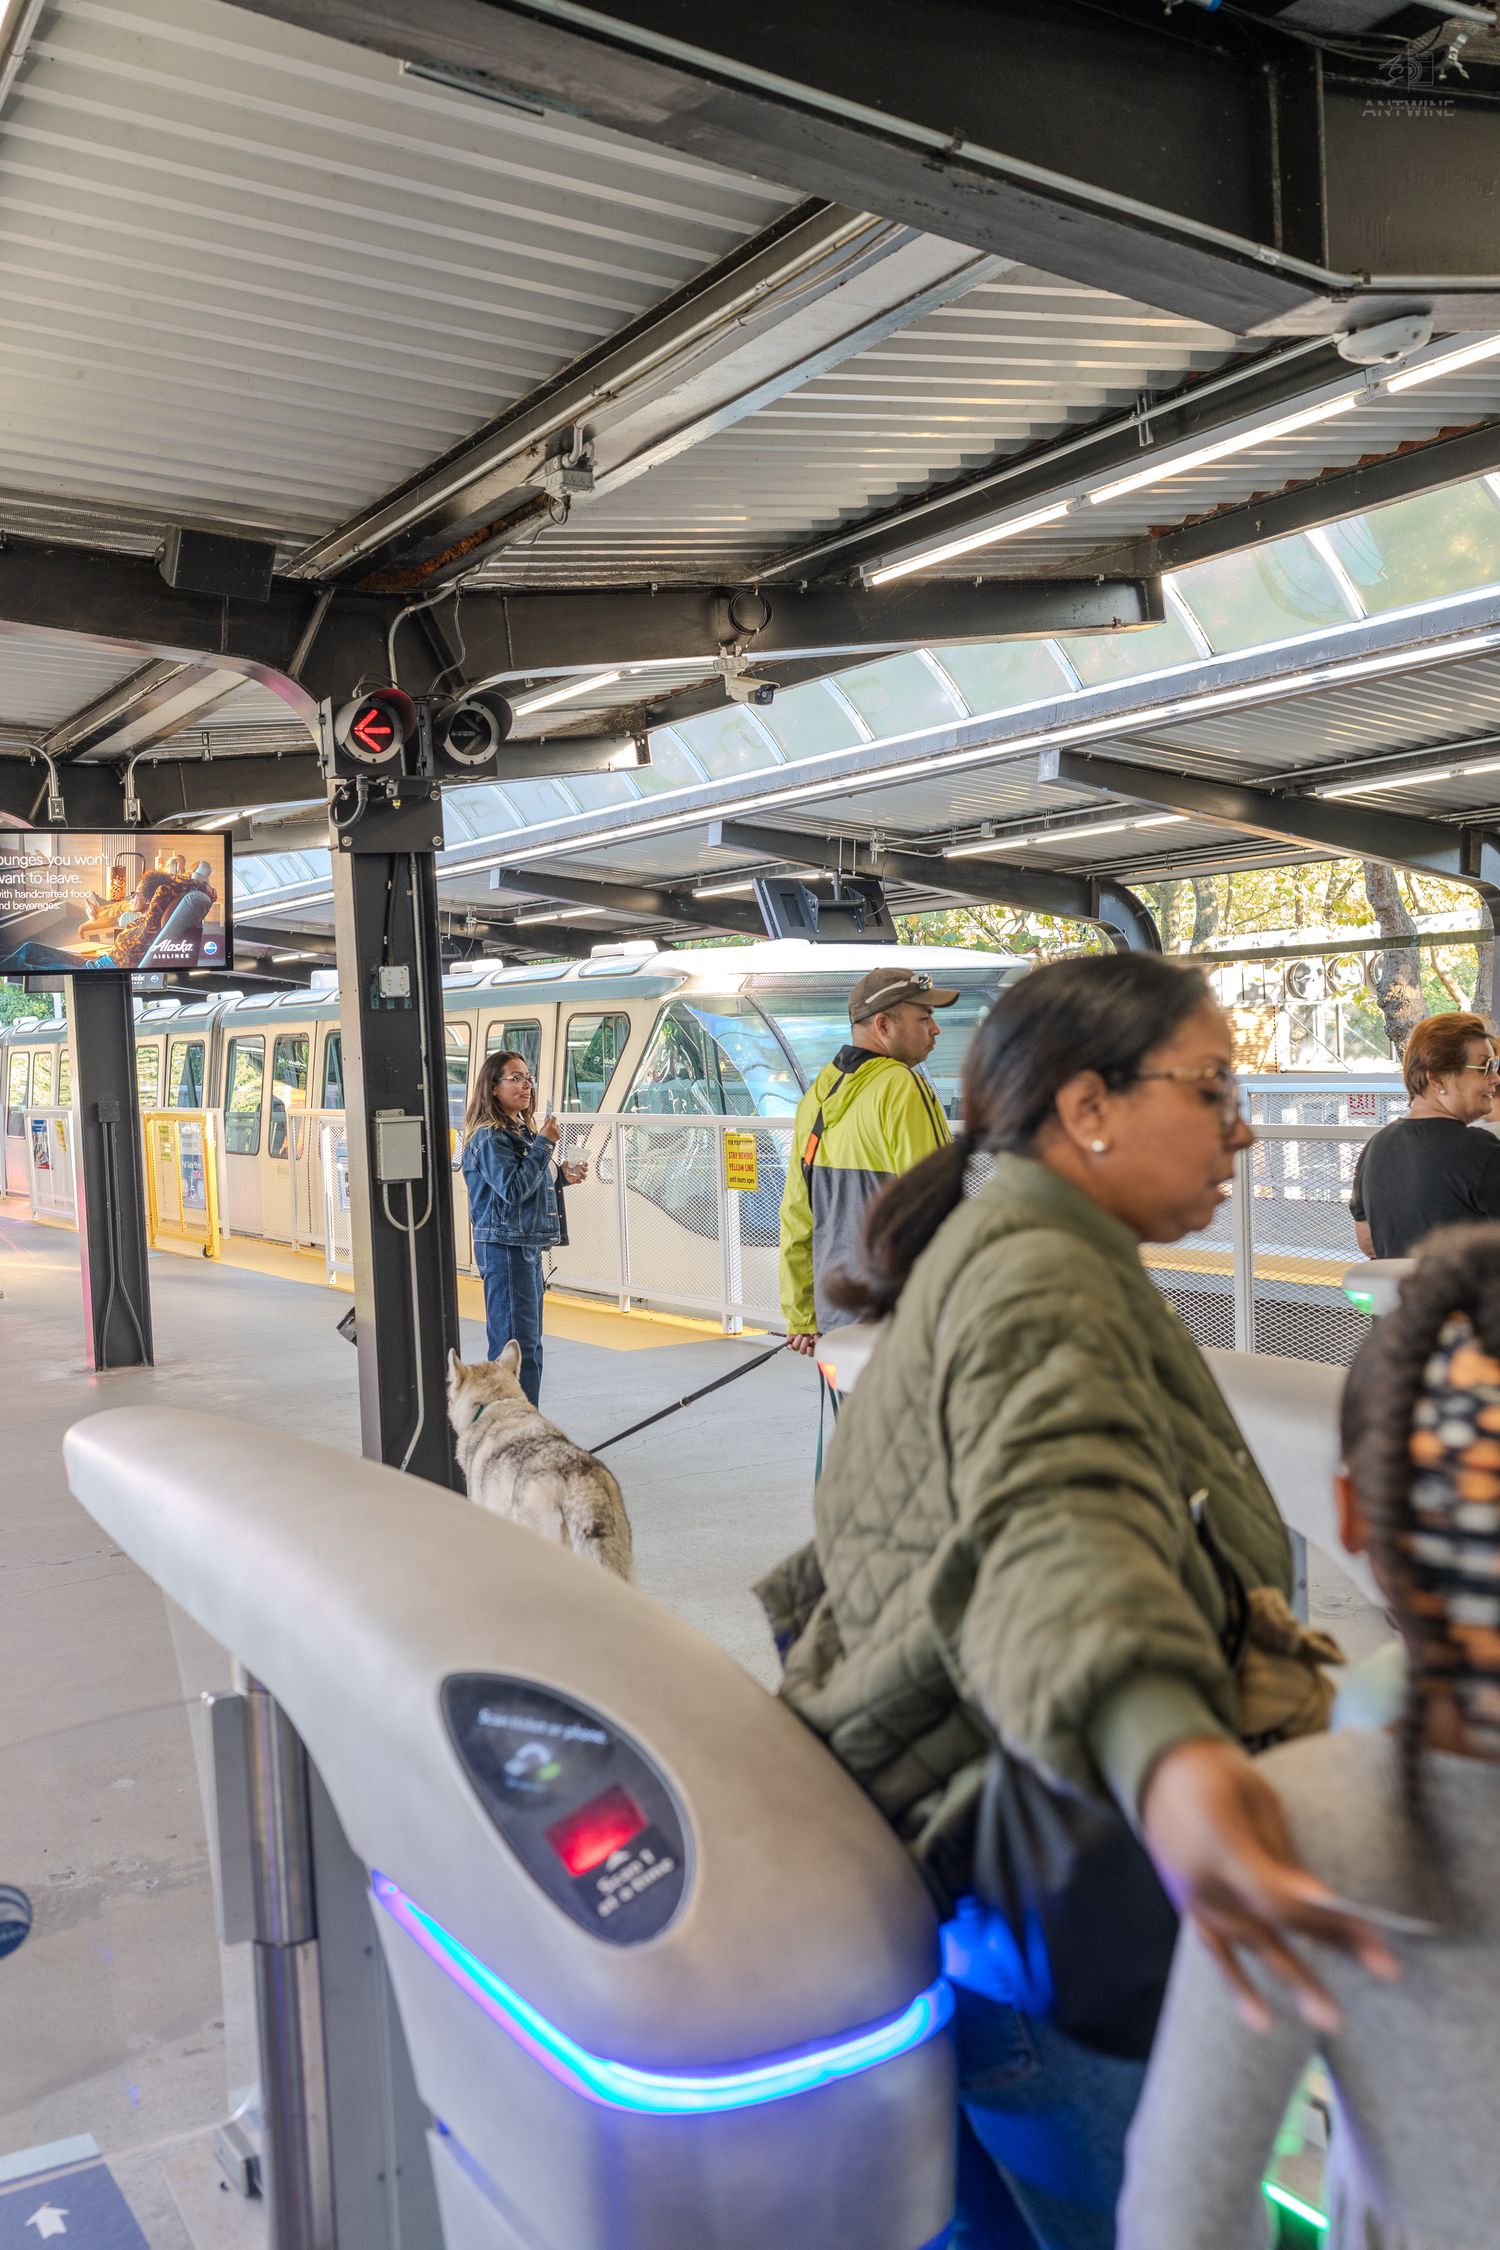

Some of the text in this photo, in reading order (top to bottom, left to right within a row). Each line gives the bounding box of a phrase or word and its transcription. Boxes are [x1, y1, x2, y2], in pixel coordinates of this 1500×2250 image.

[48, 856, 71, 868] you
[75, 853, 110, 866] won't
[30, 873, 43, 884] to
[46, 872, 83, 885] leave.
[0, 889, 92, 899] ith handcrafted food
[12, 901, 61, 911] beverages.
[151, 939, 193, 953] Alaska
[729, 1151, 753, 1160] STAY BEHIND
[728, 1163, 754, 1172] YELLOW LINE
